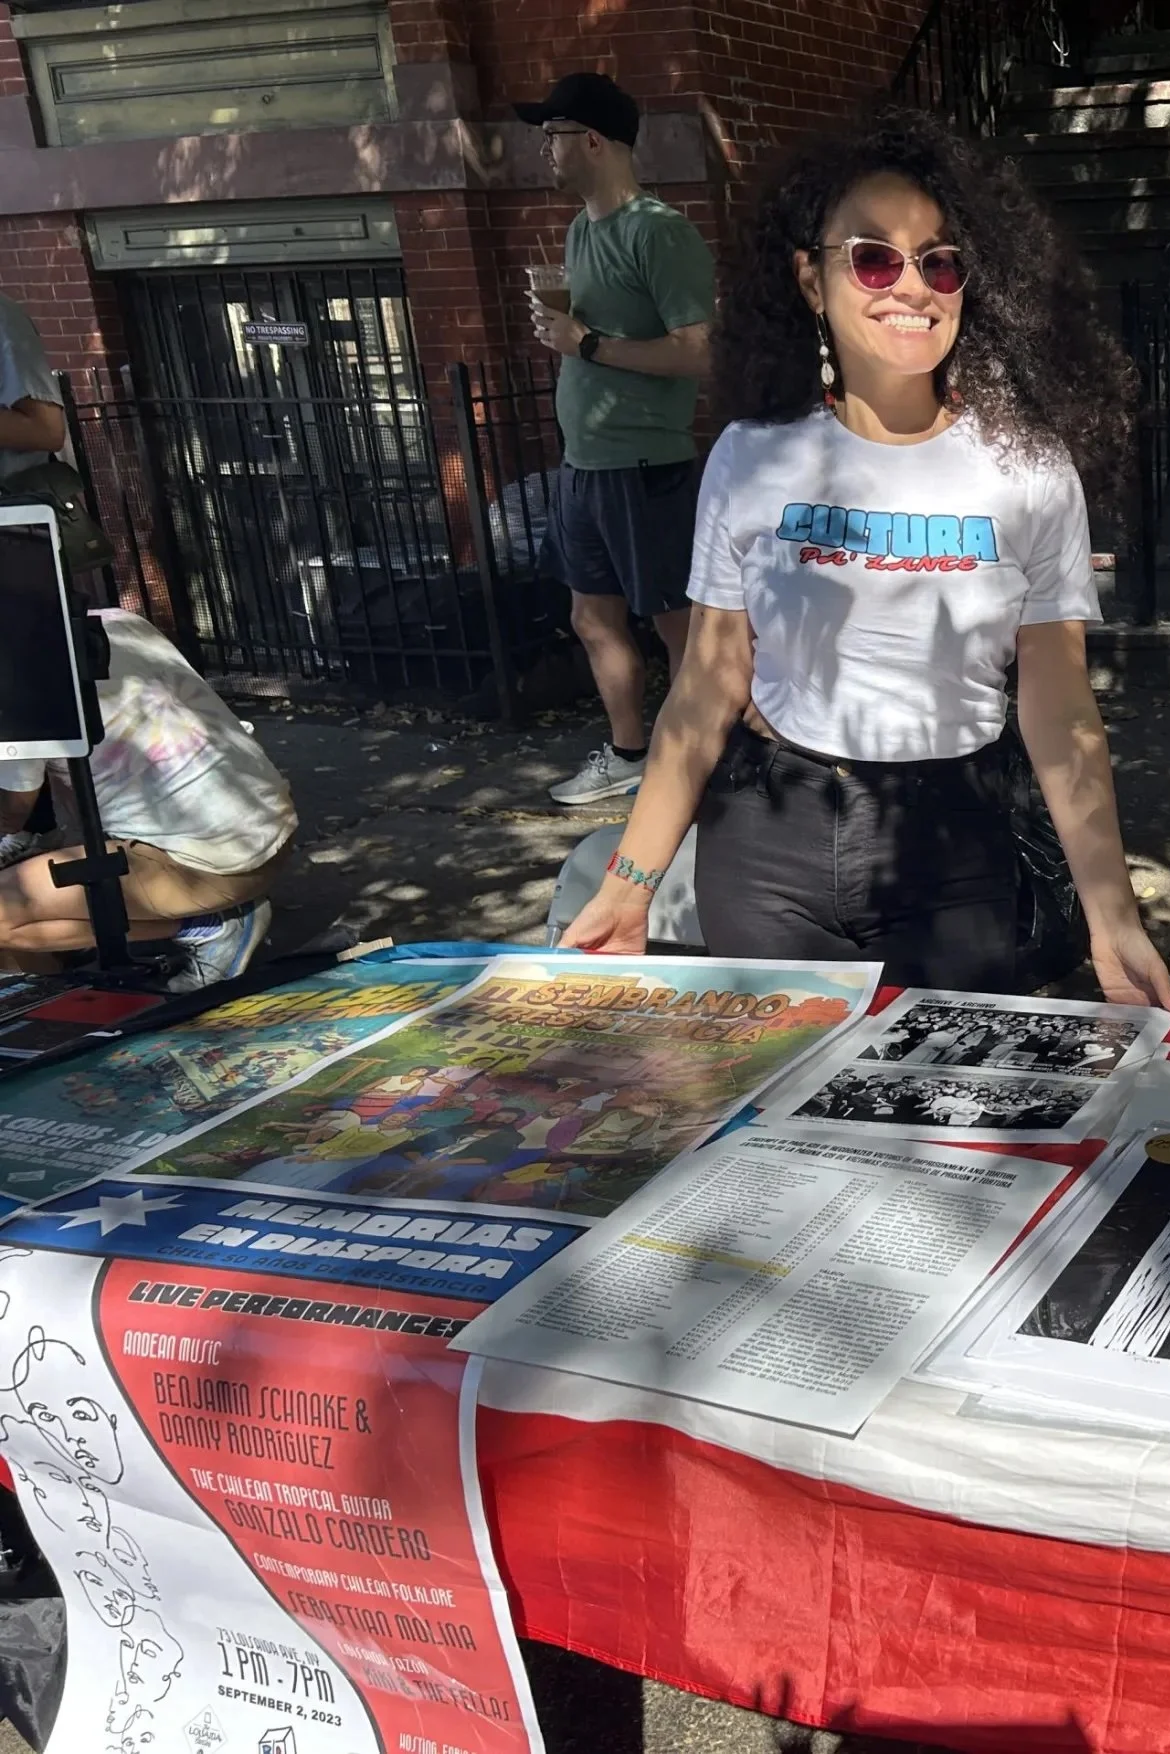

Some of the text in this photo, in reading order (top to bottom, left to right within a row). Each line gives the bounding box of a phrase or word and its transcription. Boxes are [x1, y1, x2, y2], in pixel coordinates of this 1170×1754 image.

[245, 326, 304, 335] NO TRESPASSING
[776, 503, 999, 562] CULTURA
[527, 982, 792, 1022] SEMBRANDO
[495, 1006, 767, 1044] RESISTENCIA
[912, 1158, 967, 1172] IMPRISONMENT
[967, 1166, 985, 1175] AND
[985, 1170, 1018, 1181] TORTURE
[979, 1177, 1013, 1189] TORTURA
[217, 1199, 555, 1252] MEMORIAS
[158, 1245, 488, 1294] CHILE 50 AÑOS DE RESISTENCIA
[177, 1223, 513, 1280] EN DIÁSPORA
[127, 1280, 470, 1338] LIVE PERFORMANCES
[123, 1329, 176, 1358] ANDEAN
[259, 1386, 349, 1430] SCHNAKE
[356, 1398, 372, 1434] &
[159, 1412, 221, 1451] DANNY
[190, 1468, 215, 1492] THE
[217, 1473, 273, 1502] CHILEAN
[224, 1498, 431, 1561] GONZALO CORDERO
[254, 1552, 455, 1608] CONTEMPORARY CHILEAN FOLKLORE
[216, 1627, 231, 1643] 73
[286, 1660, 335, 1704] 7PM
[413, 1679, 450, 1706] THE
[450, 1685, 510, 1722] FELLAS
[218, 1685, 342, 1727] SEPTEMBER 2, 2023
